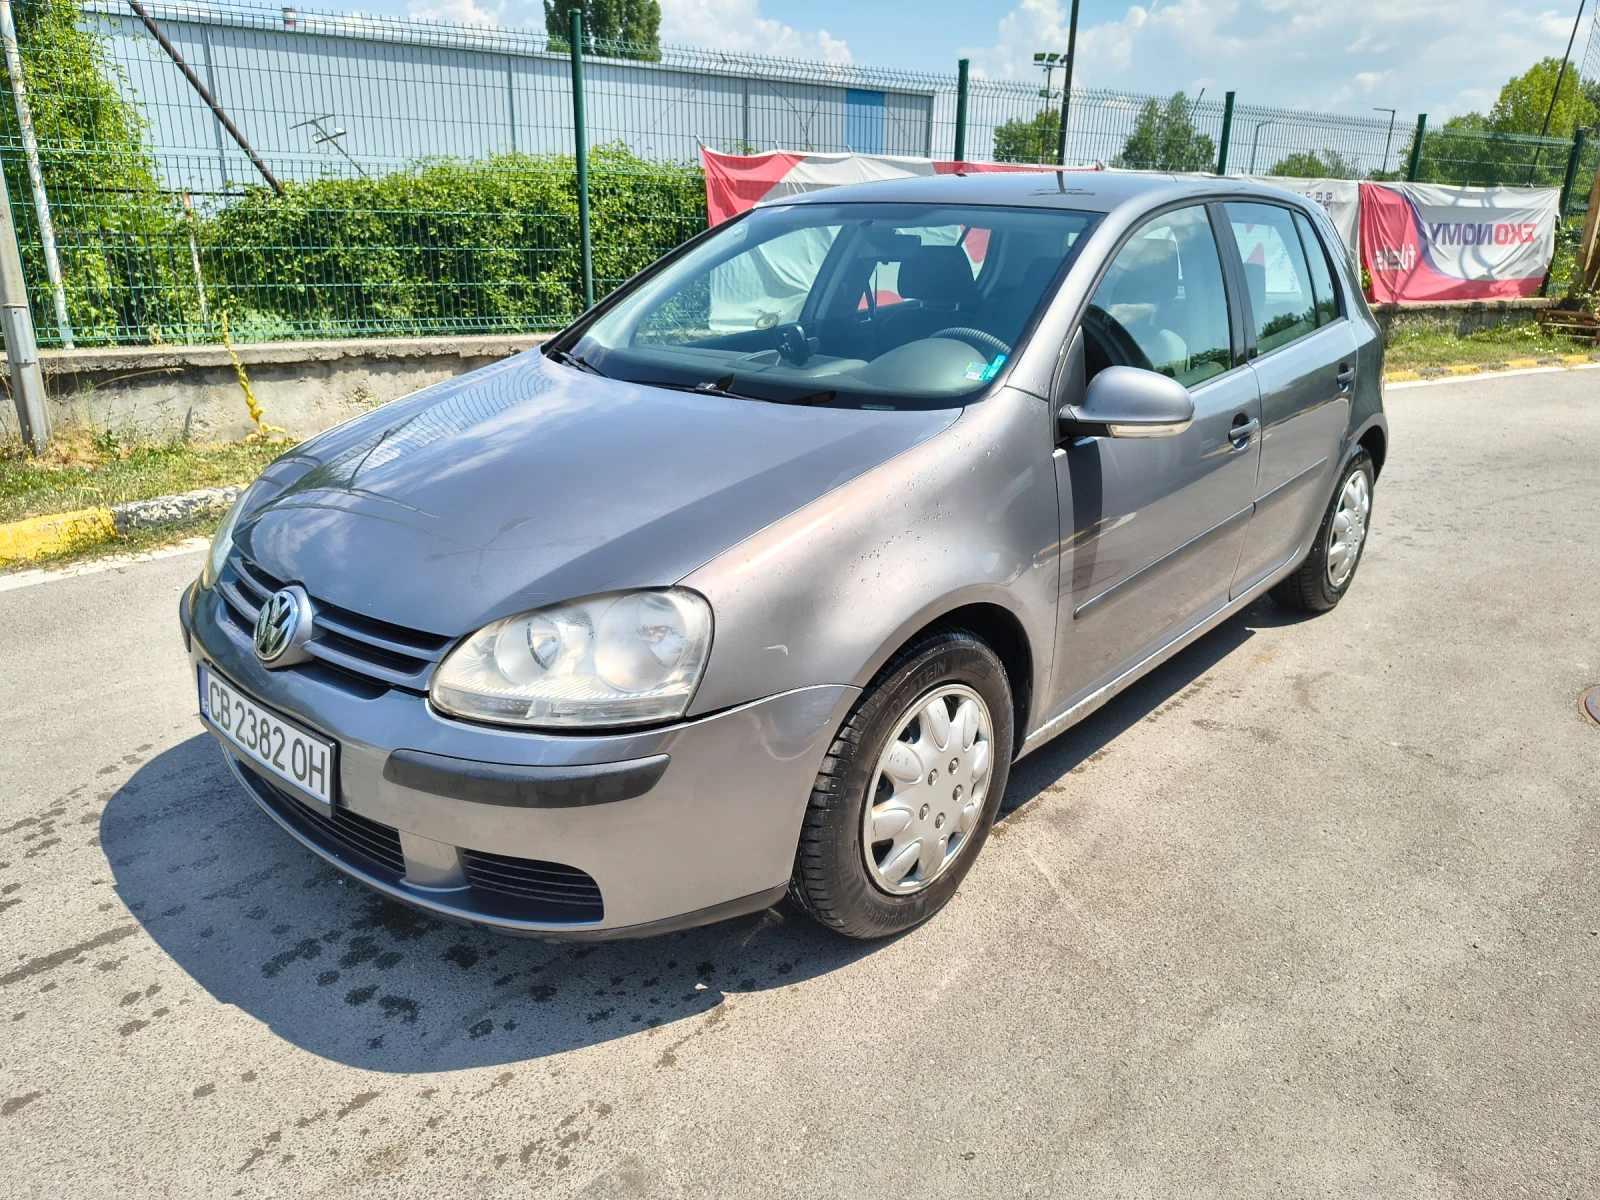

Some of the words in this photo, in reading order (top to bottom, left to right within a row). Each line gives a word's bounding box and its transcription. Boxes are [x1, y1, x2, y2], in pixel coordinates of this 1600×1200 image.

[210, 681, 231, 731] CB
[235, 701, 286, 772] 2382
[291, 738, 325, 795] OH
[869, 658, 947, 748] REDESTEIN
